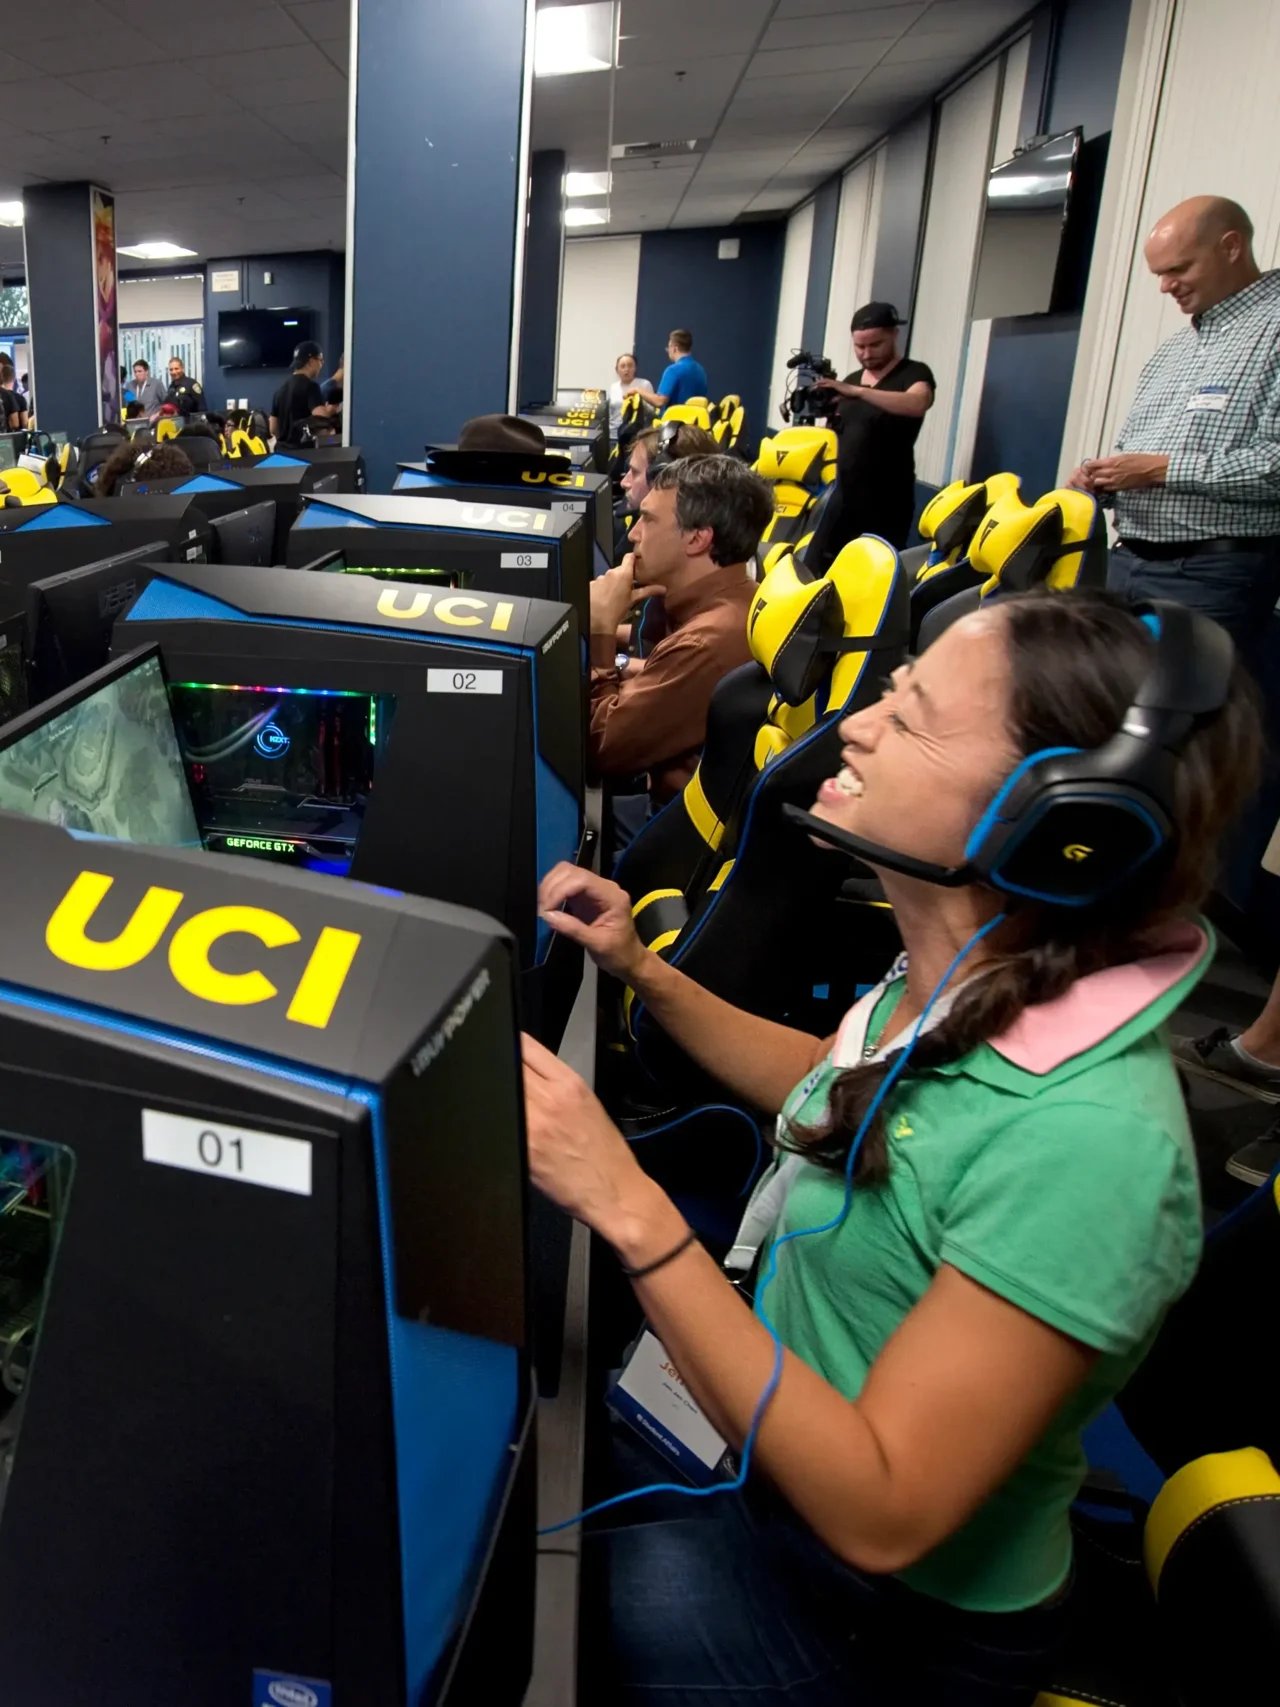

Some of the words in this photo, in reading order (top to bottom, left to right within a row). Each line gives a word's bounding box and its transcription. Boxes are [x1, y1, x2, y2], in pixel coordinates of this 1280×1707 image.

[557, 418, 590, 427] UCI
[521, 470, 585, 487] UCI
[563, 503, 574, 512] 04
[461, 505, 547, 531] UCI
[516, 555, 532, 567] 03
[376, 588, 514, 632] UCI
[452, 672, 477, 691] 02
[226, 836, 272, 851] GEFORCE
[273, 841, 295, 853] GTX
[45, 870, 362, 1029] UCI
[197, 1129, 244, 1173] 01
